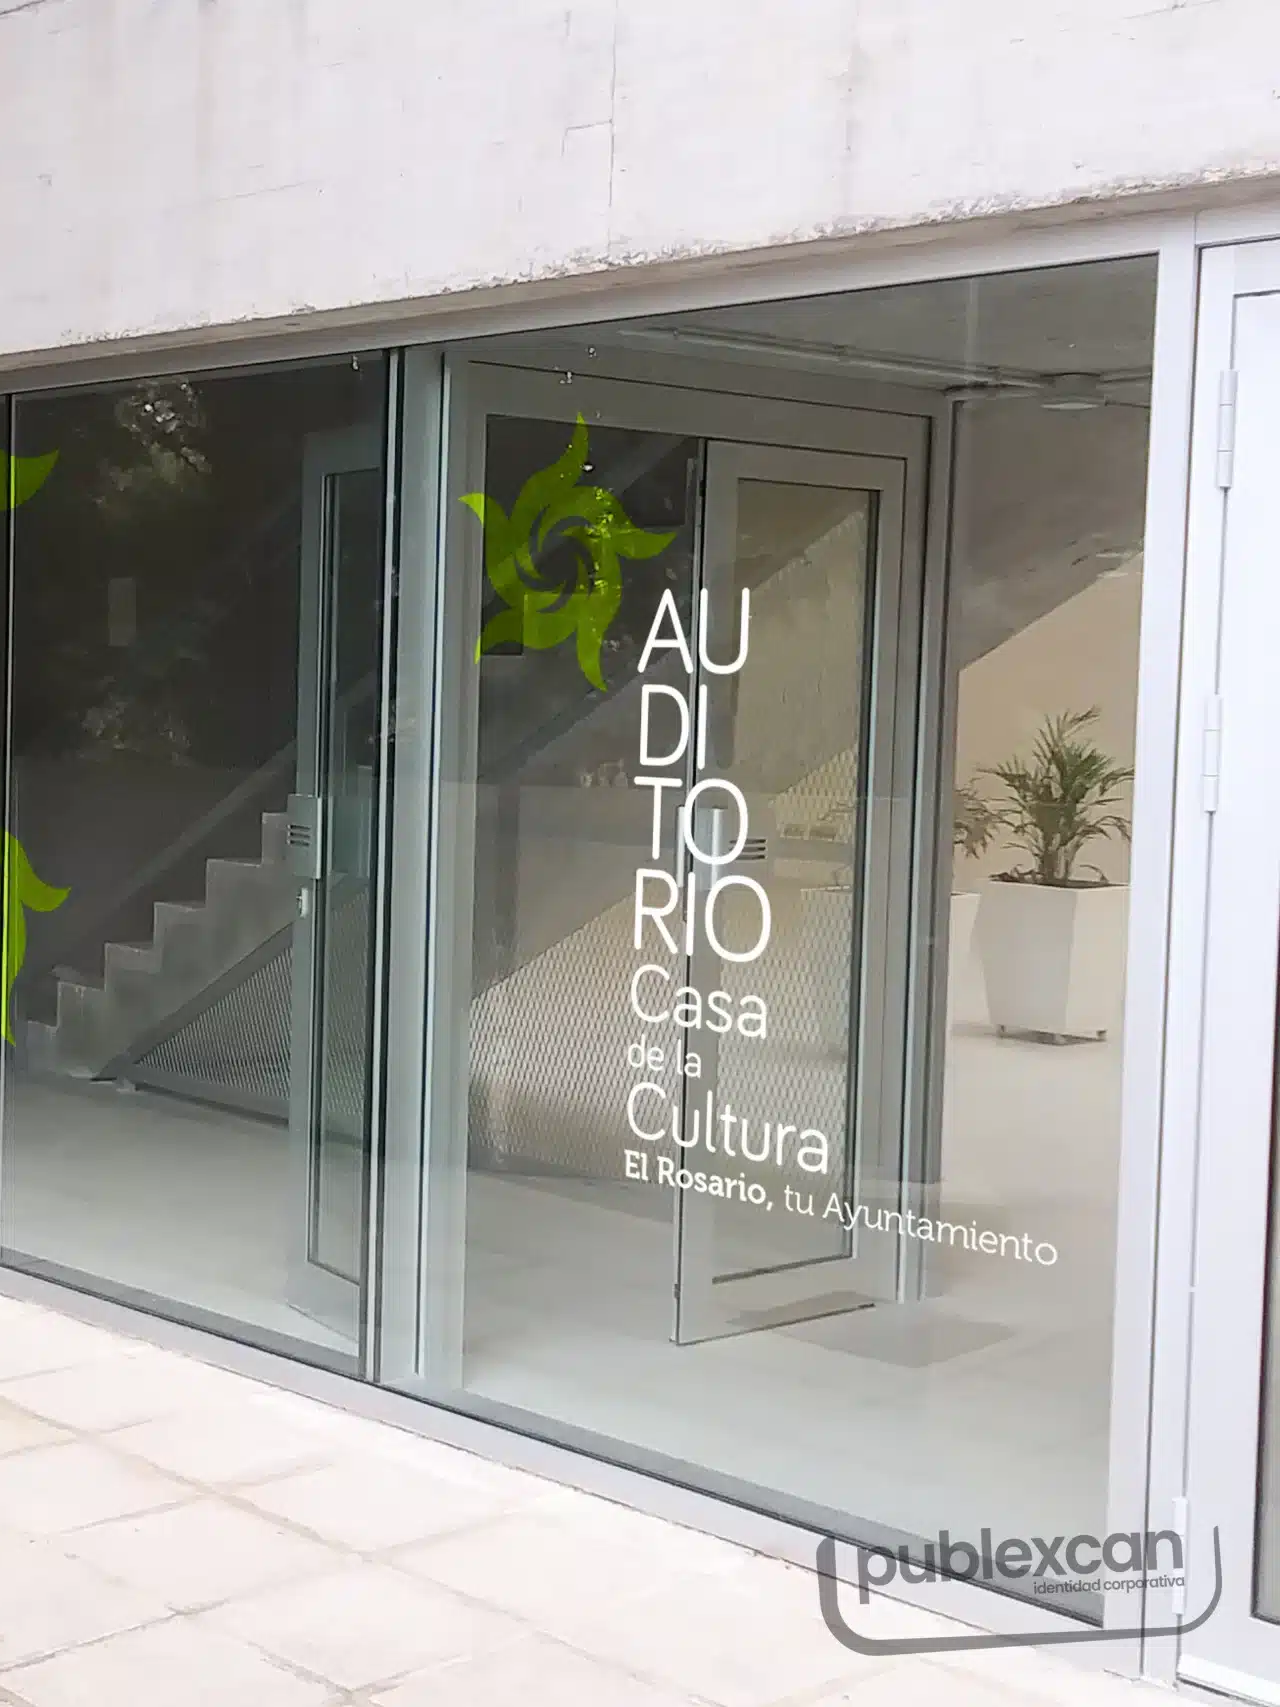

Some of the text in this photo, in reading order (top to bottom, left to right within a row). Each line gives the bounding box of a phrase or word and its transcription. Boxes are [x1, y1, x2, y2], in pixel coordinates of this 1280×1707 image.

[637, 588, 750, 674] AU
[639, 684, 708, 770] DI
[634, 776, 749, 865] TO
[633, 869, 772, 963] RIO
[630, 964, 768, 1039] Casa
[627, 1037, 702, 1078] de la
[626, 1082, 829, 1175] Cultura
[623, 1149, 1058, 1266] El Rosario, tu Ayuntamiento
